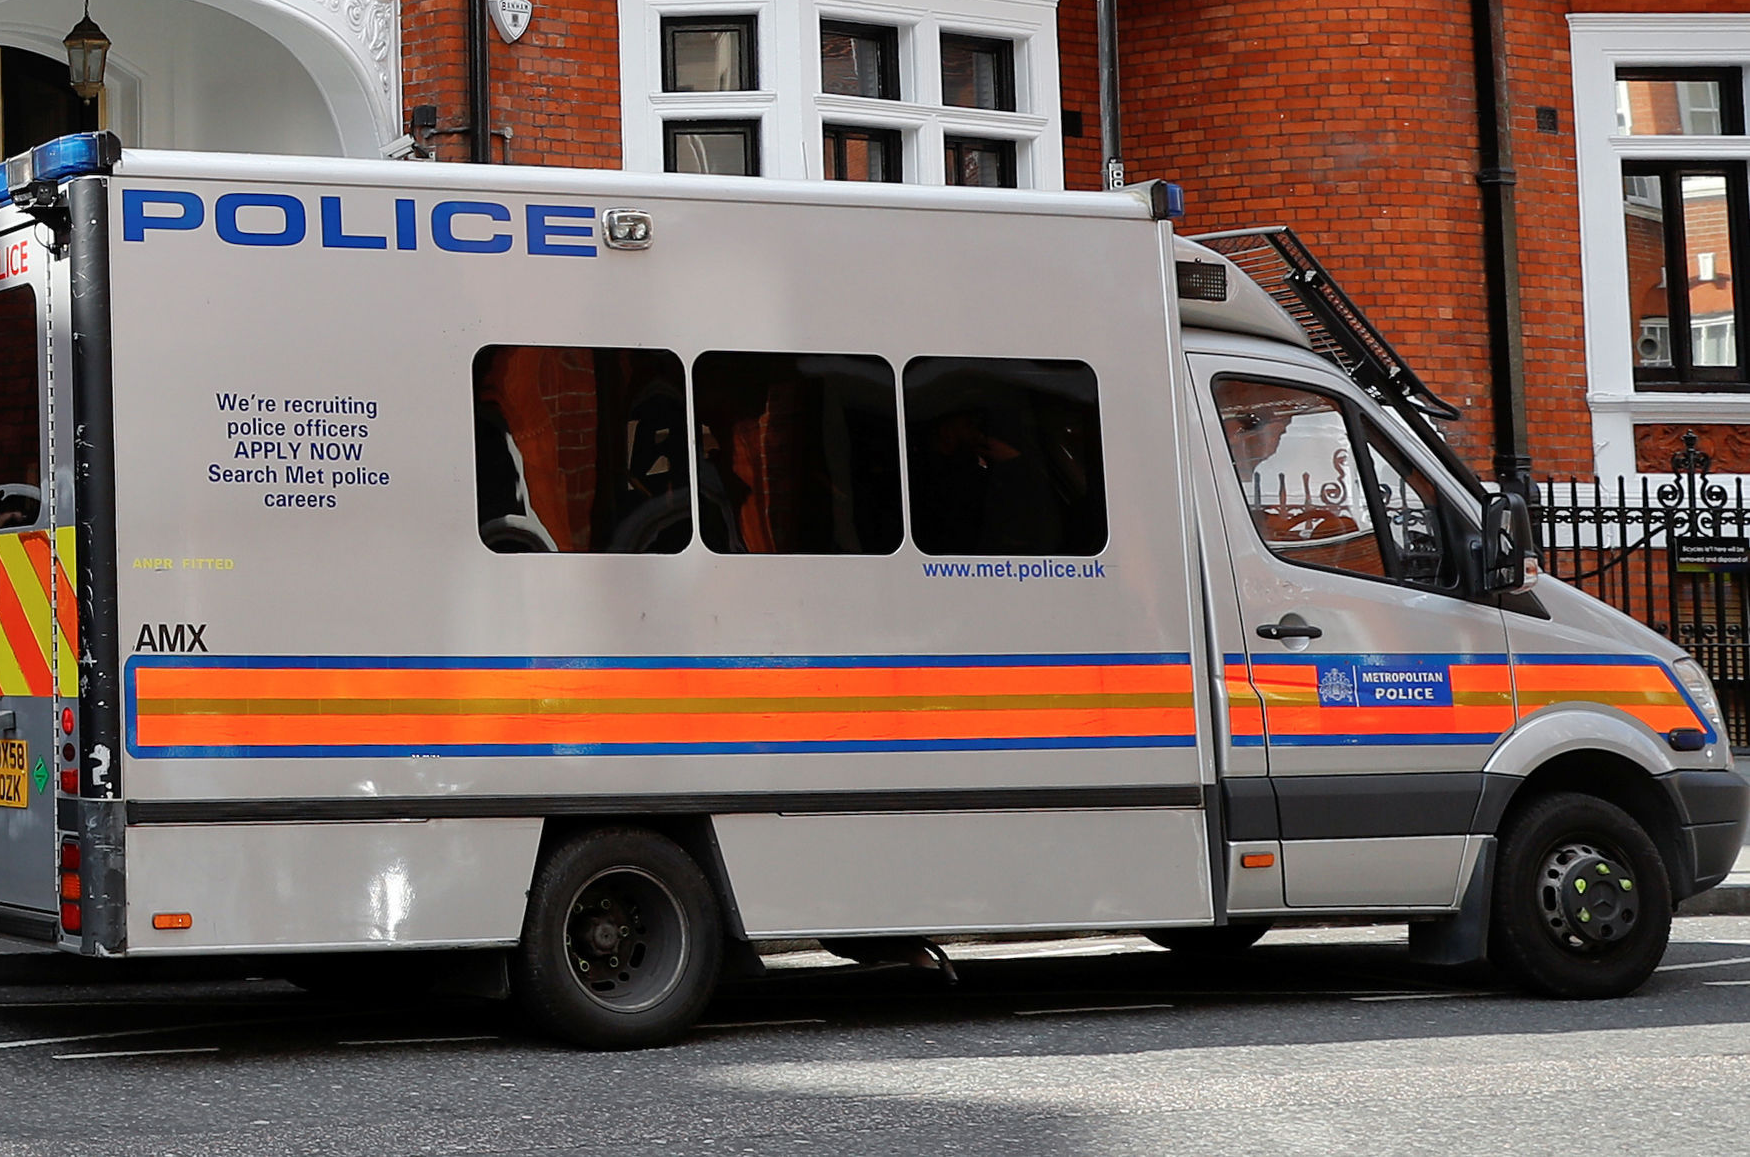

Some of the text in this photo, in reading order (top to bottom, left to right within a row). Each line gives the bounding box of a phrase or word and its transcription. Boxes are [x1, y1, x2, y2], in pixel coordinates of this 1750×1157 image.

[122, 189, 597, 257] POLICE
[215, 392, 378, 419] We're recruiting
[227, 418, 369, 439] police officers
[234, 441, 363, 461] APPLY NOW
[208, 464, 390, 488] Search Met police
[264, 493, 337, 508] careers
[132, 558, 235, 570] ANPR FITTED
[922, 560, 1106, 582] www.met.police.uk
[135, 623, 209, 653] AMX
[1362, 672, 1444, 683] METROPOLITAN
[1375, 687, 1435, 700] POLICE
